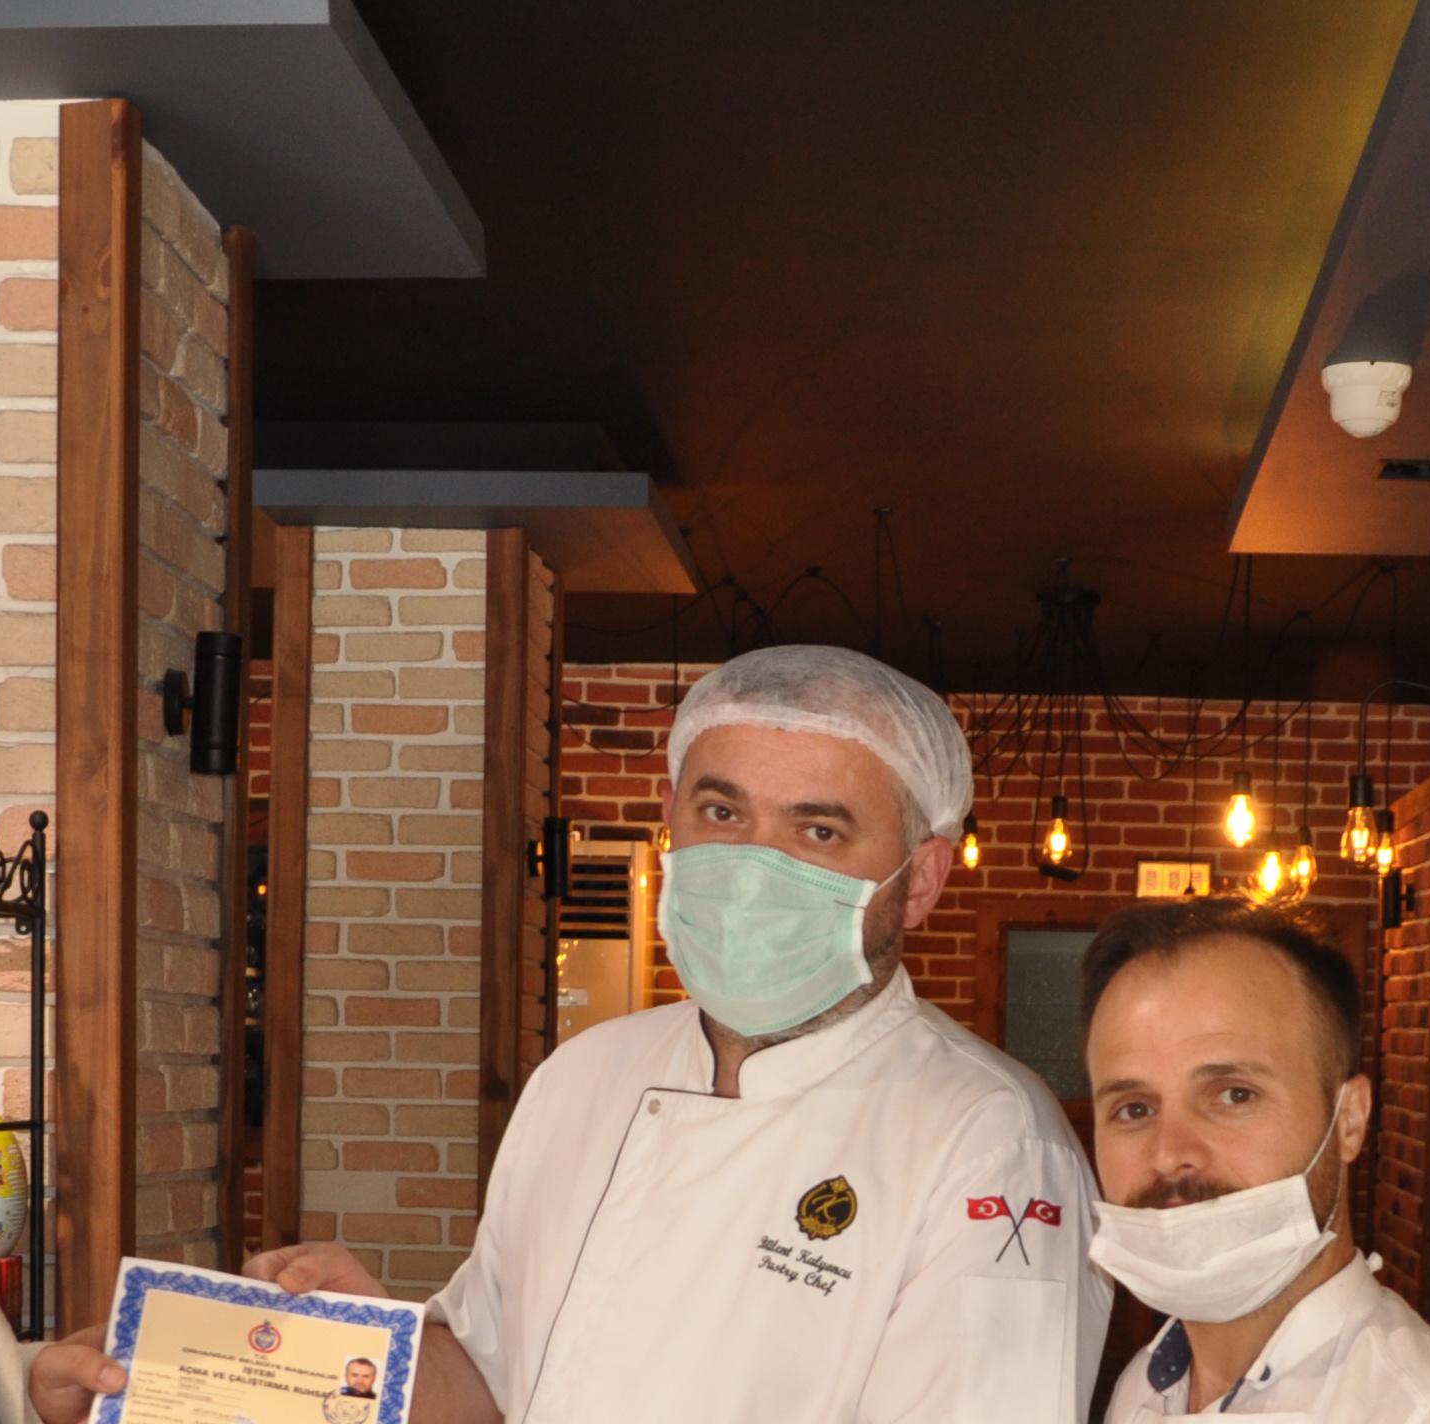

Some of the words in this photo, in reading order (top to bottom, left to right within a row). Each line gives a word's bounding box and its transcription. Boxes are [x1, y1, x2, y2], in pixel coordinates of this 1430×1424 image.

[803, 1271, 837, 1297] Chef
[178, 1364, 209, 1377] AÇMA
[213, 1371, 225, 1380] VE
